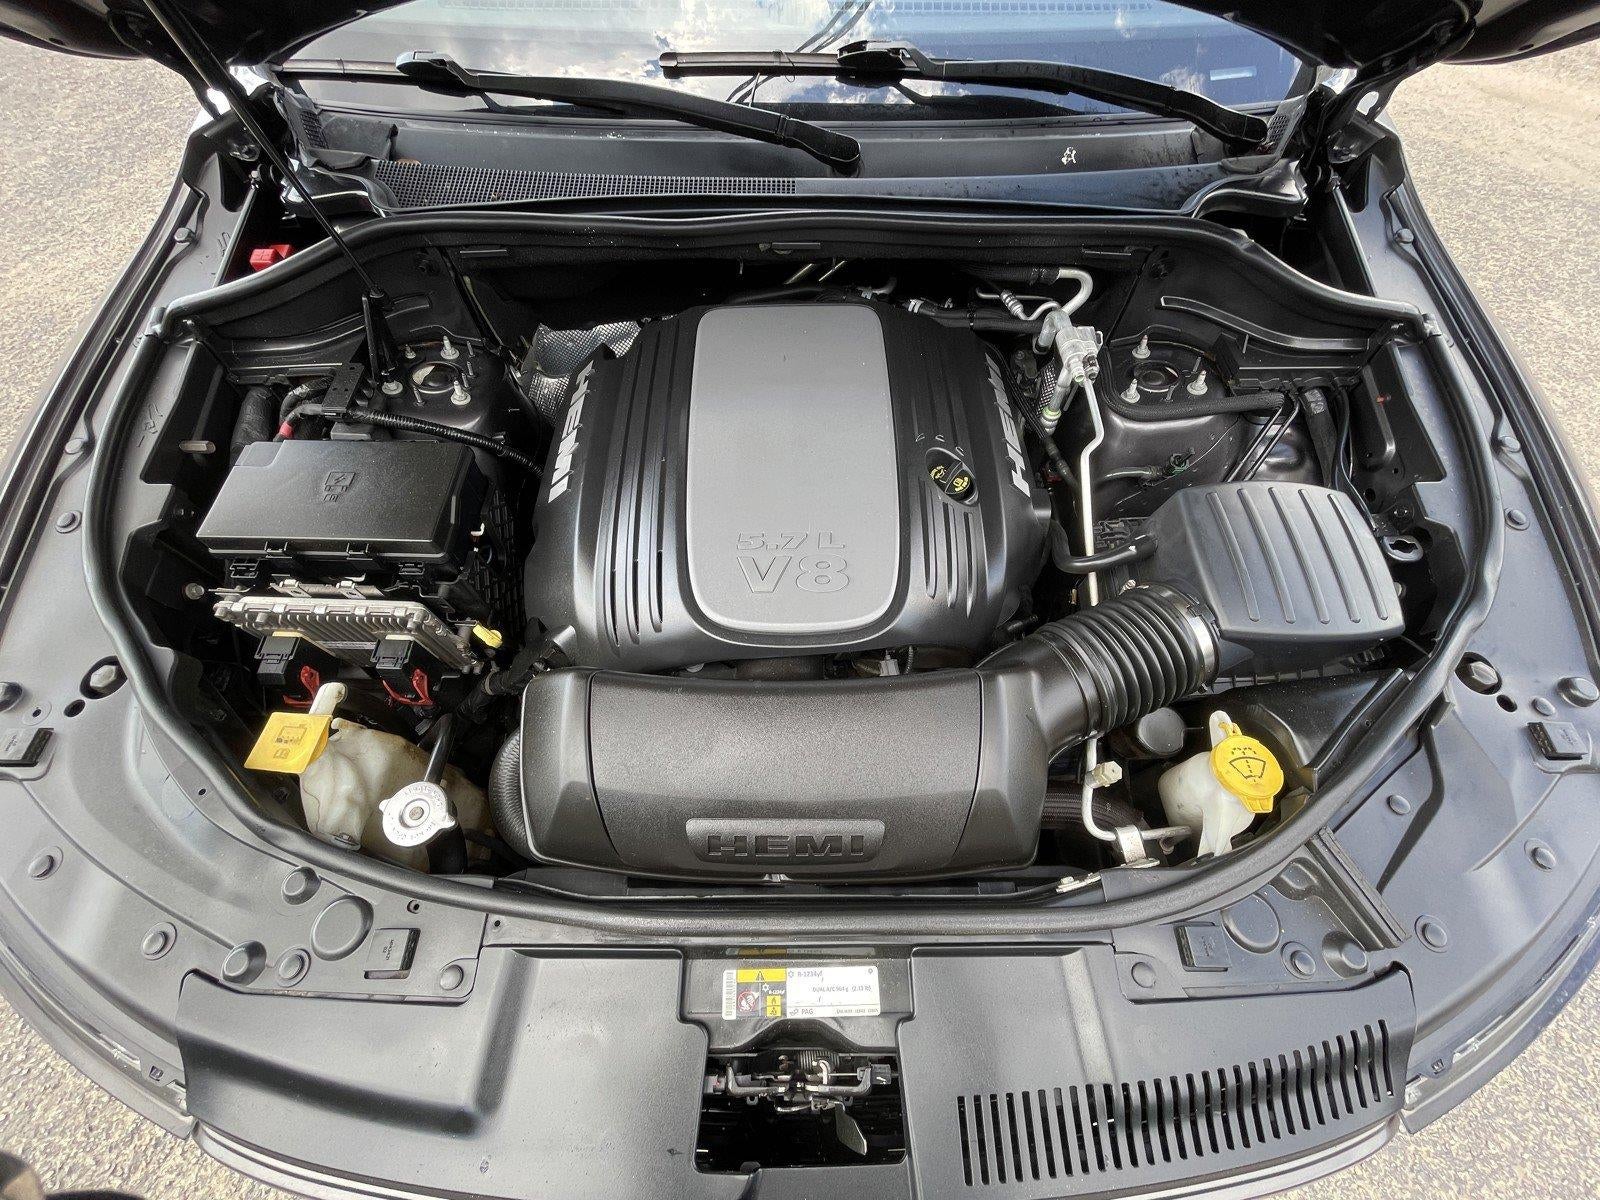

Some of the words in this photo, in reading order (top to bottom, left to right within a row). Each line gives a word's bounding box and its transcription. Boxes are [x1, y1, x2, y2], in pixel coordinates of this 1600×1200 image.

[548, 360, 594, 504] HEMI
[985, 352, 1031, 498] HEMI
[736, 530, 846, 551] 5.7L
[736, 554, 850, 593] V8
[707, 835, 864, 857] HEMI
[801, 1008, 814, 1016] PAG
